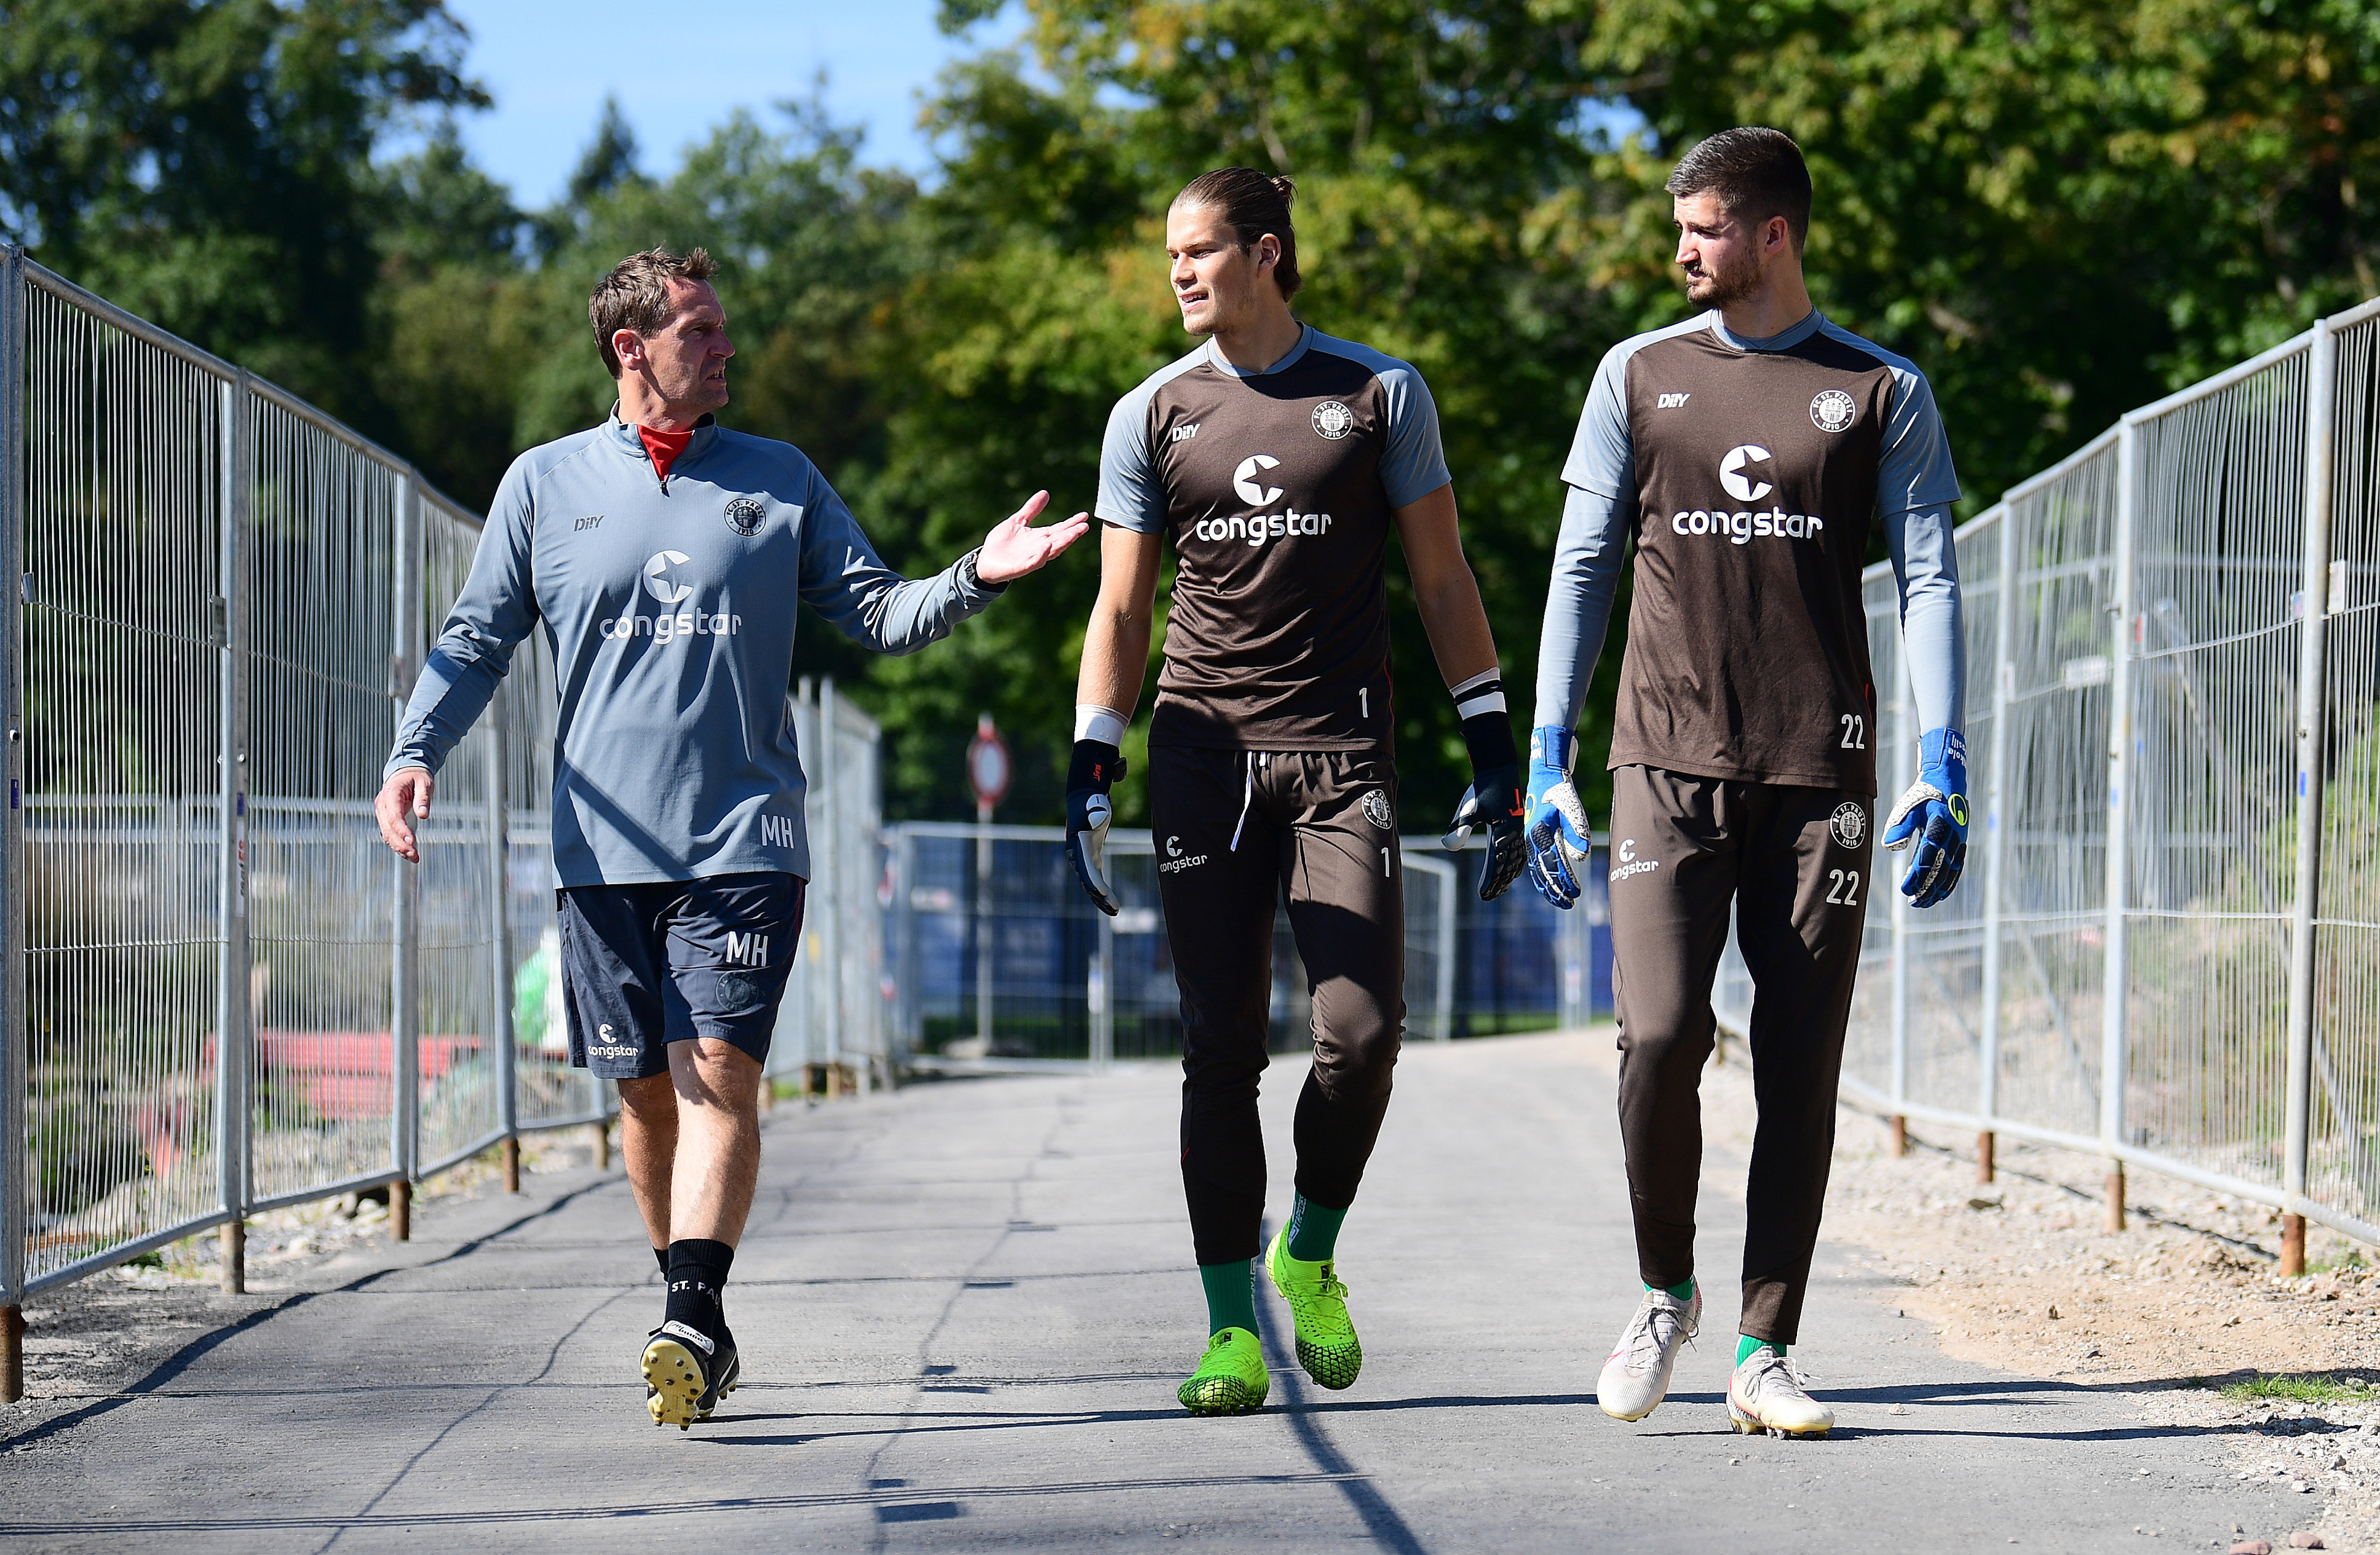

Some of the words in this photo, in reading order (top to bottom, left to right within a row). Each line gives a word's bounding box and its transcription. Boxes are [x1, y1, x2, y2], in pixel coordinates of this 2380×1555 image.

[1331, 403, 1351, 420] PAULI
[1835, 393, 1853, 413] PAULI
[1822, 422, 1840, 430] 1910
[745, 501, 764, 518] PAULI
[1196, 507, 1331, 547] congstar
[1672, 506, 1823, 545] congstar
[598, 607, 742, 645] congstar
[1359, 687, 1368, 718] 1
[1841, 714, 1865, 750] 22
[1850, 805, 1865, 826] PAULI
[761, 813, 795, 849] MH
[1160, 855, 1208, 873] congstar
[1381, 847, 1390, 877] 1
[1825, 869, 1859, 906] 22
[726, 930, 768, 967] MH
[587, 1045, 638, 1059] congstar
[672, 1280, 690, 1292] ST.
